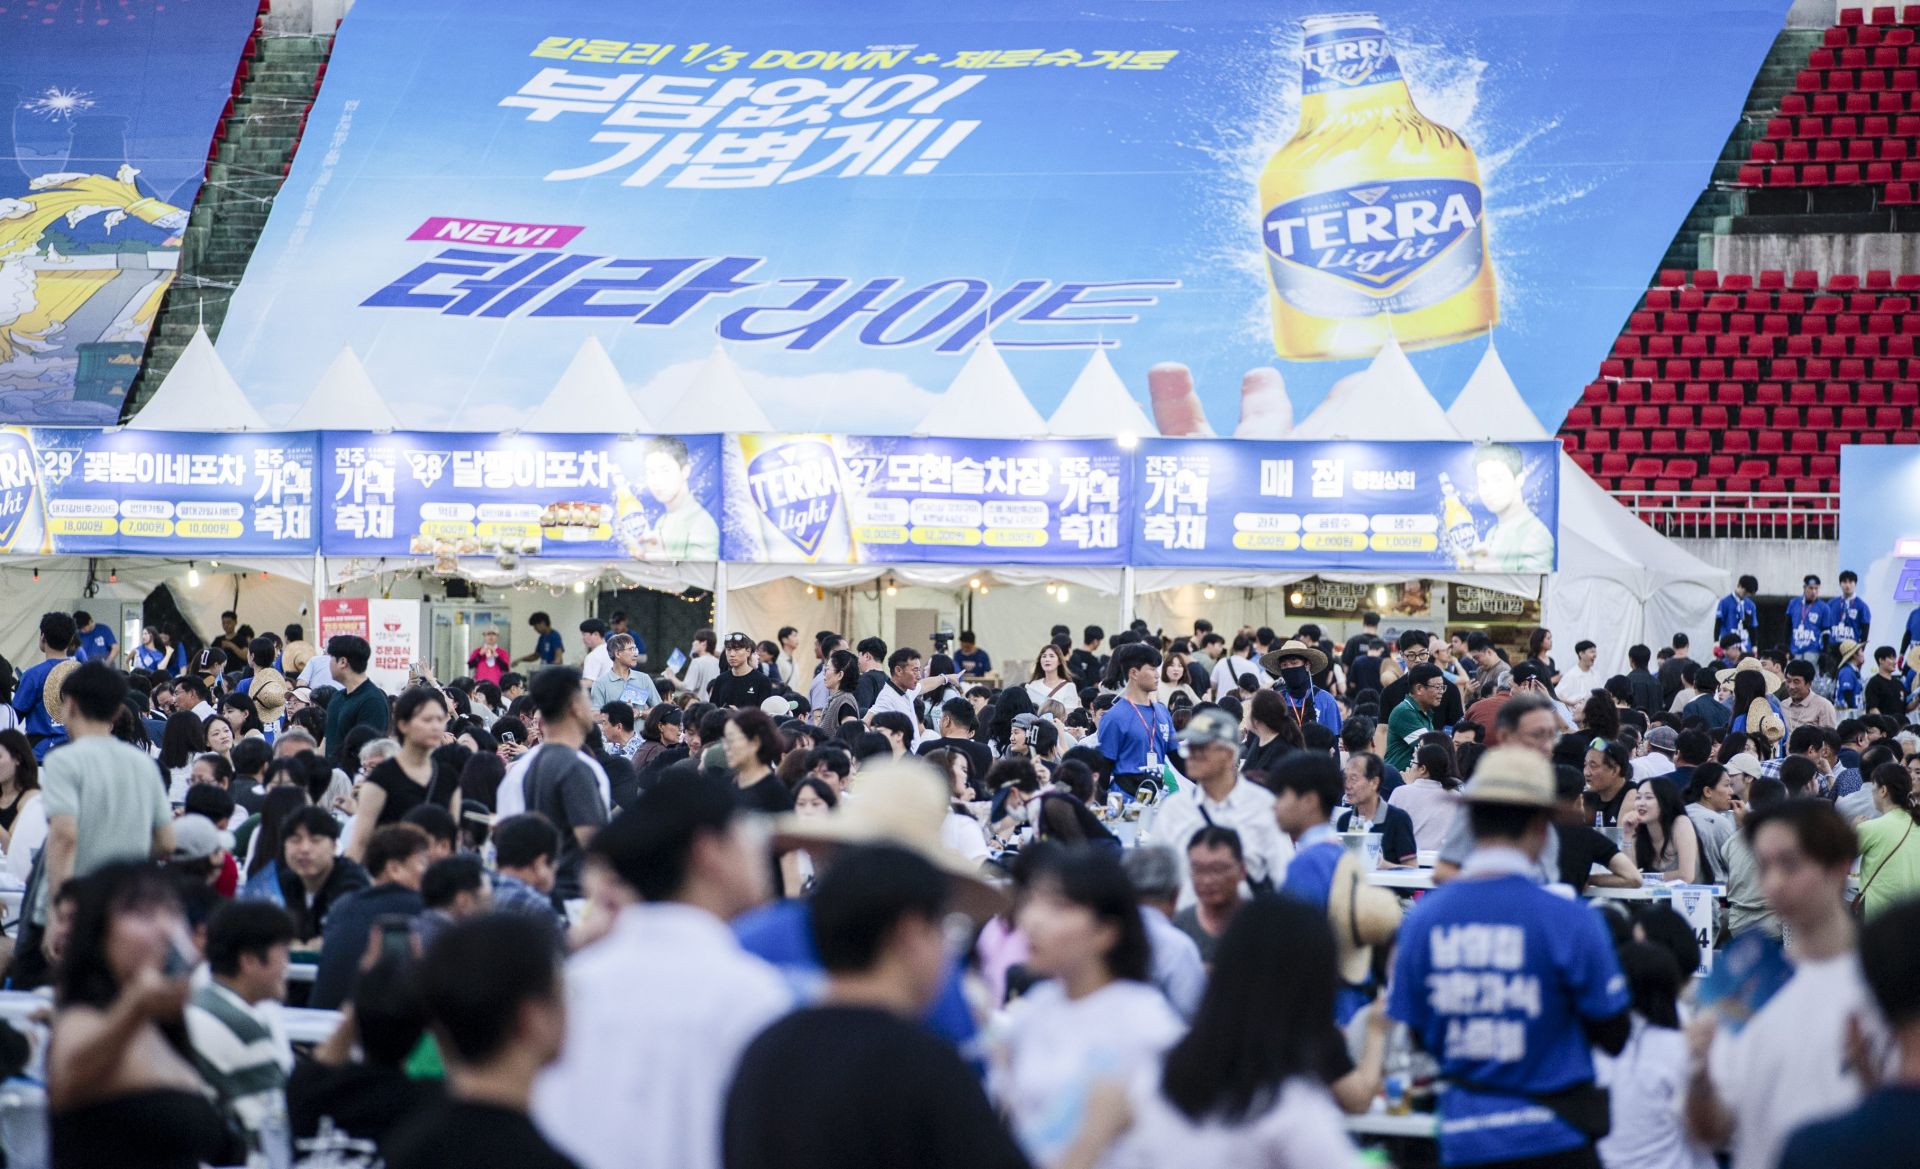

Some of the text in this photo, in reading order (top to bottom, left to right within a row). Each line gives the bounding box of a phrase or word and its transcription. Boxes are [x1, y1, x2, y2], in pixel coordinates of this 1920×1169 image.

[530, 36, 676, 66] 칼로리
[679, 42, 749, 72] 1/3
[757, 49, 910, 71] DOWN
[941, 48, 1181, 72] 제로슈거로
[1301, 38, 1396, 71] TERRA
[498, 67, 988, 129] 부담없이
[542, 118, 983, 190] 가볍게!
[434, 220, 559, 246] NEW!
[1267, 193, 1478, 257] TERRA
[1317, 238, 1438, 273] Light
[357, 247, 1183, 353] 테라 라이트
[44, 451, 246, 486] 29 꽃분이네포차
[254, 448, 284, 470] 전주
[335, 447, 365, 467] 전주
[413, 454, 442, 480] 28
[453, 450, 612, 489] 달팽이포차
[1060, 457, 1090, 476] 전주
[1145, 456, 1177, 477] 전주
[254, 460, 313, 504] 가맥
[335, 460, 395, 503] 가맥
[749, 456, 843, 514] TERRA
[849, 458, 878, 489] 27
[1144, 468, 1208, 514] 가맥
[63, 520, 104, 532] 18,000원
[128, 520, 165, 533] 7,000원
[189, 523, 230, 535] 10,000원
[254, 504, 313, 541] 축제
[335, 504, 395, 539] 축제
[778, 500, 830, 533] Light
[1060, 514, 1119, 549] 축제
[1144, 514, 1206, 550] 축제
[1257, 517, 1280, 528] 과자
[1320, 518, 1351, 529] 음료수
[1394, 518, 1415, 529] 생수
[1247, 535, 1286, 547] 2,000원
[1315, 535, 1354, 547] 2,000원
[1385, 535, 1422, 548] 1,000원
[1317, 594, 1358, 611] 먹태깡
[1456, 599, 1525, 615] 농심 먹태깡
[375, 645, 411, 655] 주문음식
